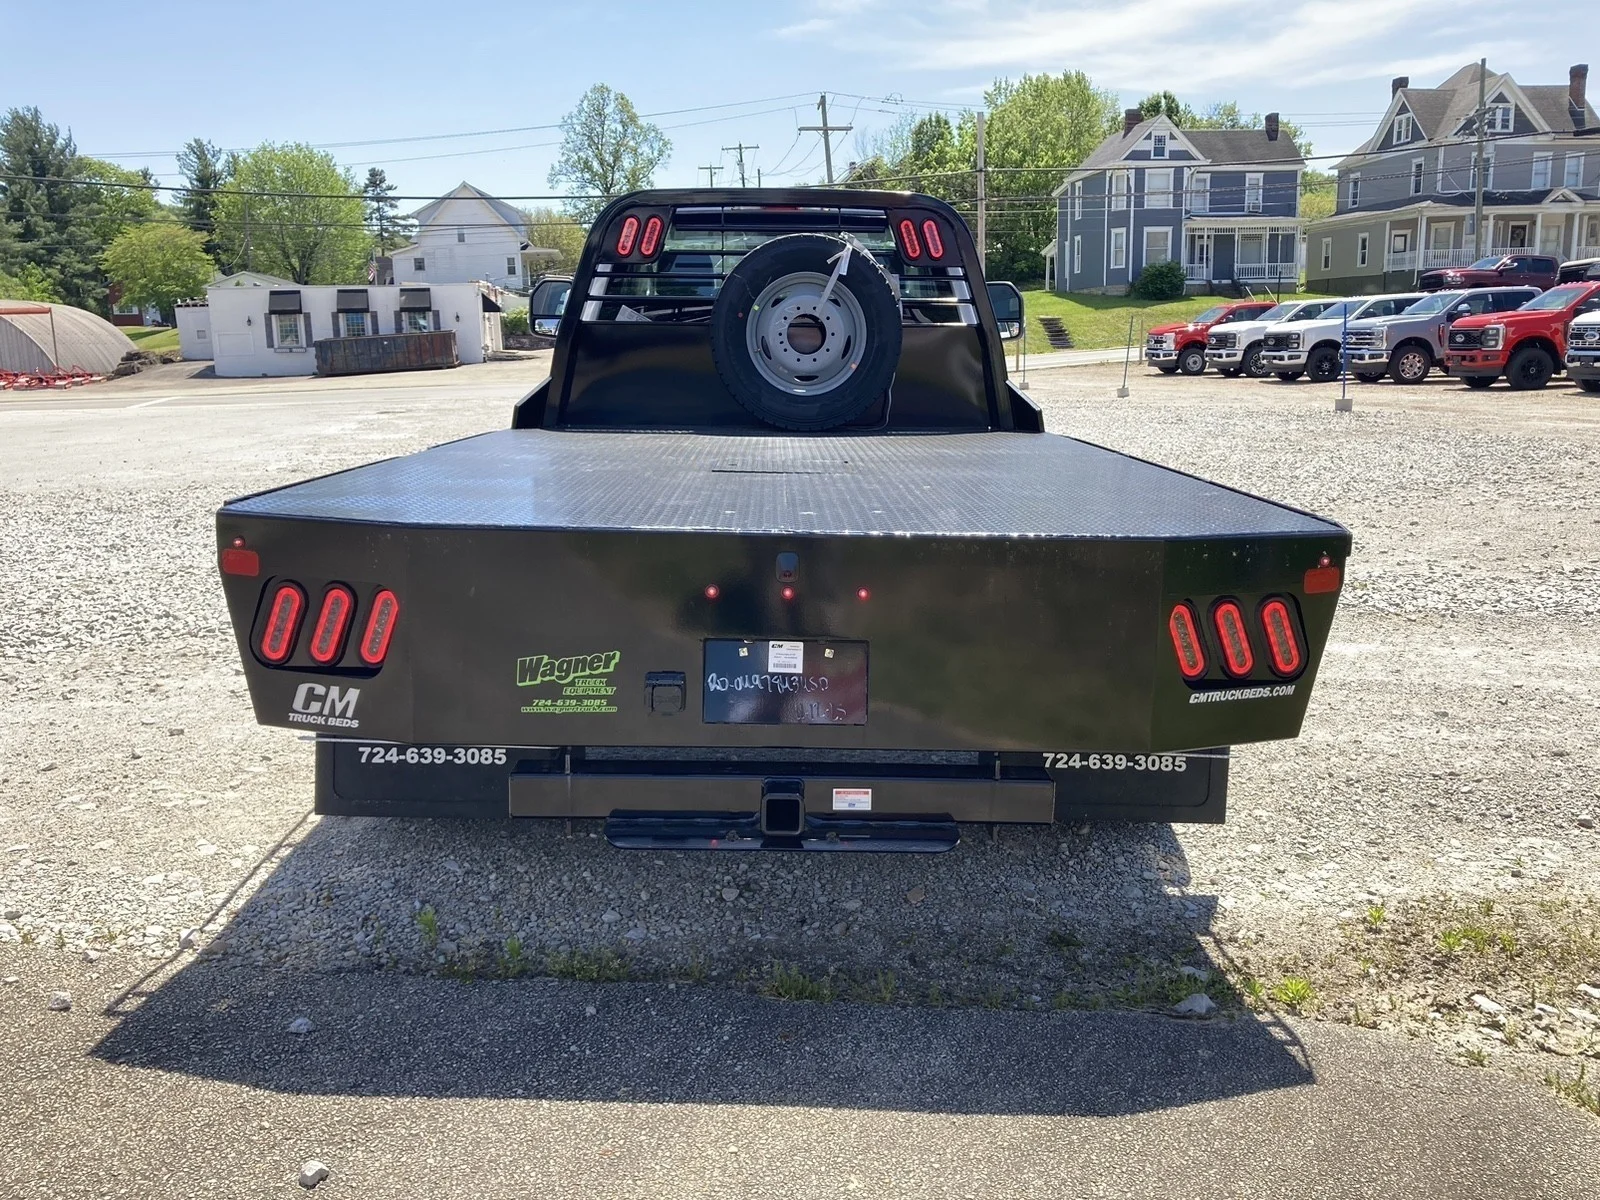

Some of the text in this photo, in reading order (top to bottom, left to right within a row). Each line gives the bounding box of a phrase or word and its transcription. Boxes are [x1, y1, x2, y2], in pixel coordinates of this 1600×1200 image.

[517, 651, 621, 686] Wagner
[563, 687, 616, 696] EQUIPMENT
[575, 679, 607, 687] TRUCK
[292, 682, 360, 718] CM
[532, 699, 607, 707] 724-639-3085
[1189, 685, 1296, 704] CMTRUCKBEDS.COM
[288, 712, 360, 729] TRUCK BEDS
[358, 746, 507, 765] 724-639-3085
[1042, 752, 1188, 772] 724-639-3085
